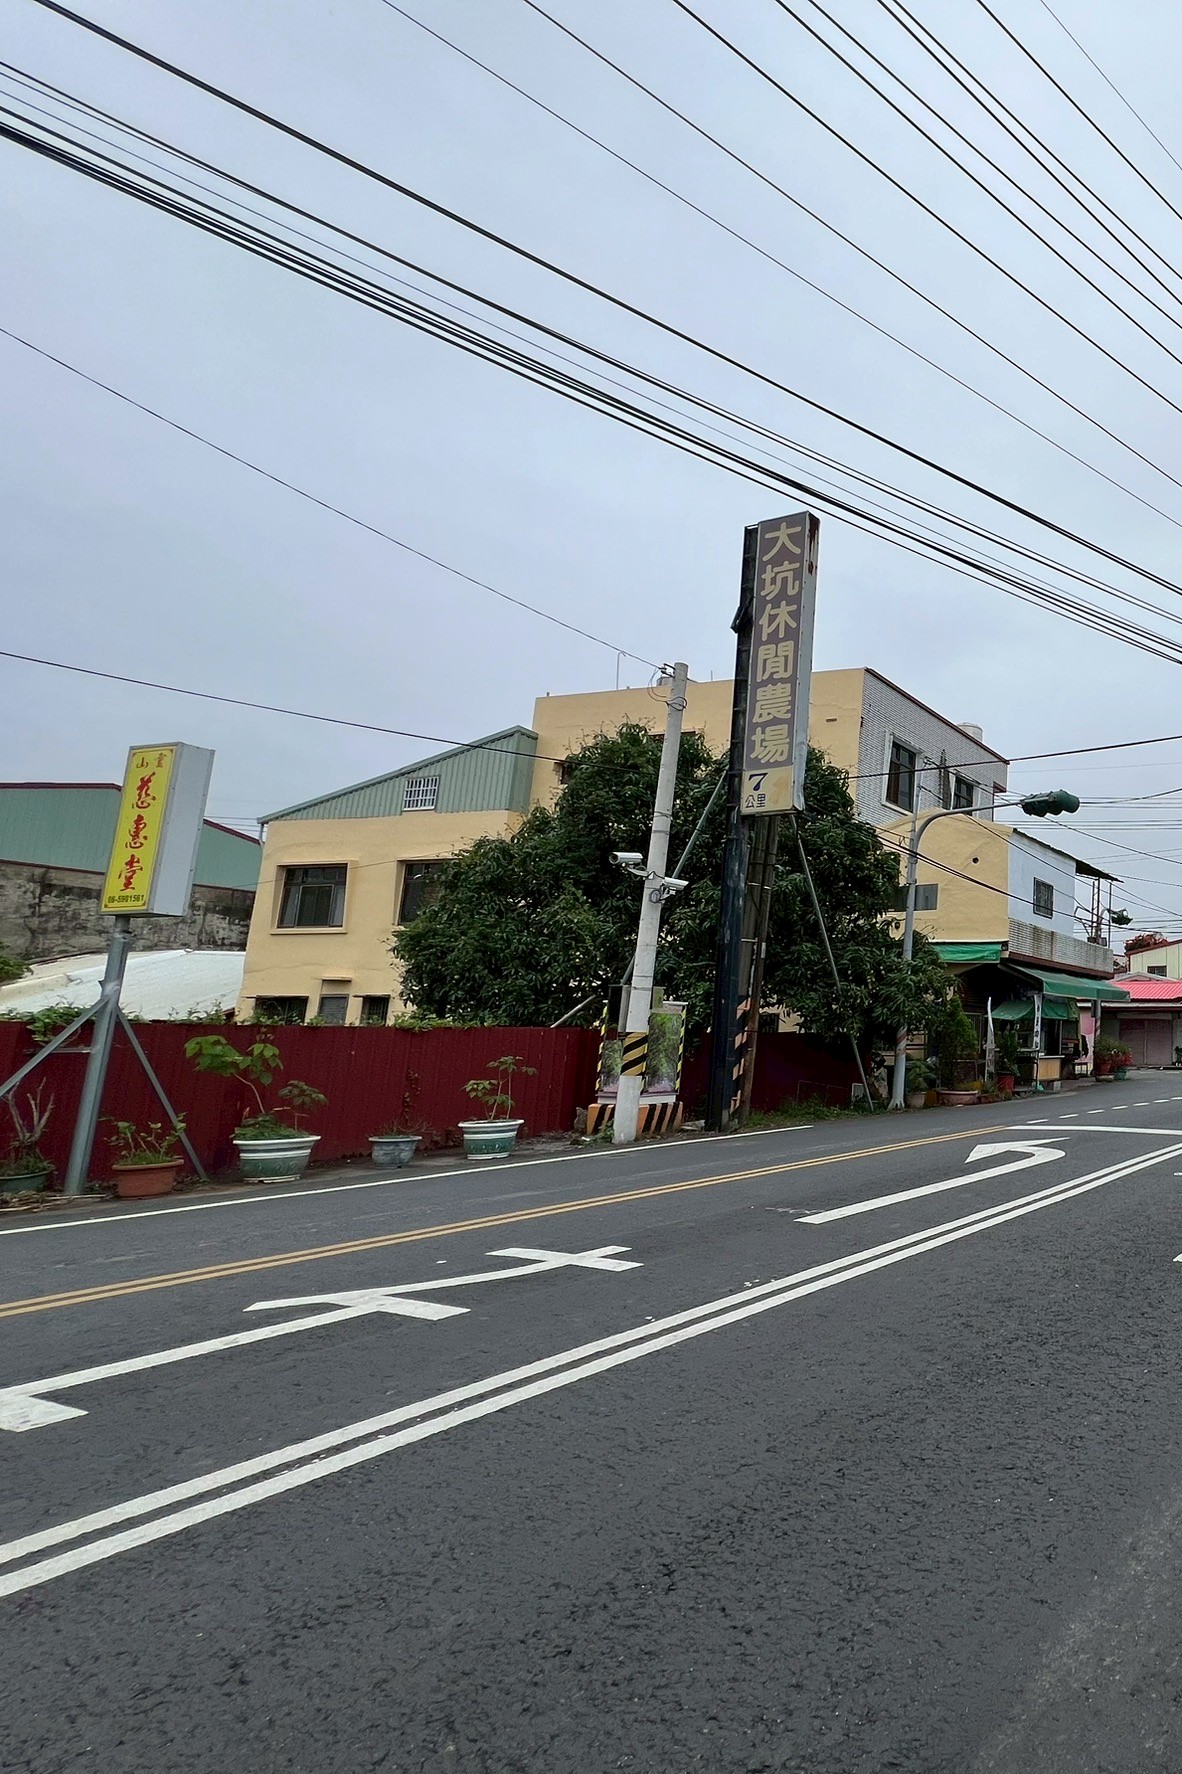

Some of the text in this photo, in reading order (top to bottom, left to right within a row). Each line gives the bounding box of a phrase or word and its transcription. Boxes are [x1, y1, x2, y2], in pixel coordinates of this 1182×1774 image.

[750, 522, 802, 764] 大坑休閒農場
[748, 772, 768, 792] 7
[745, 793, 766, 809] 公里
